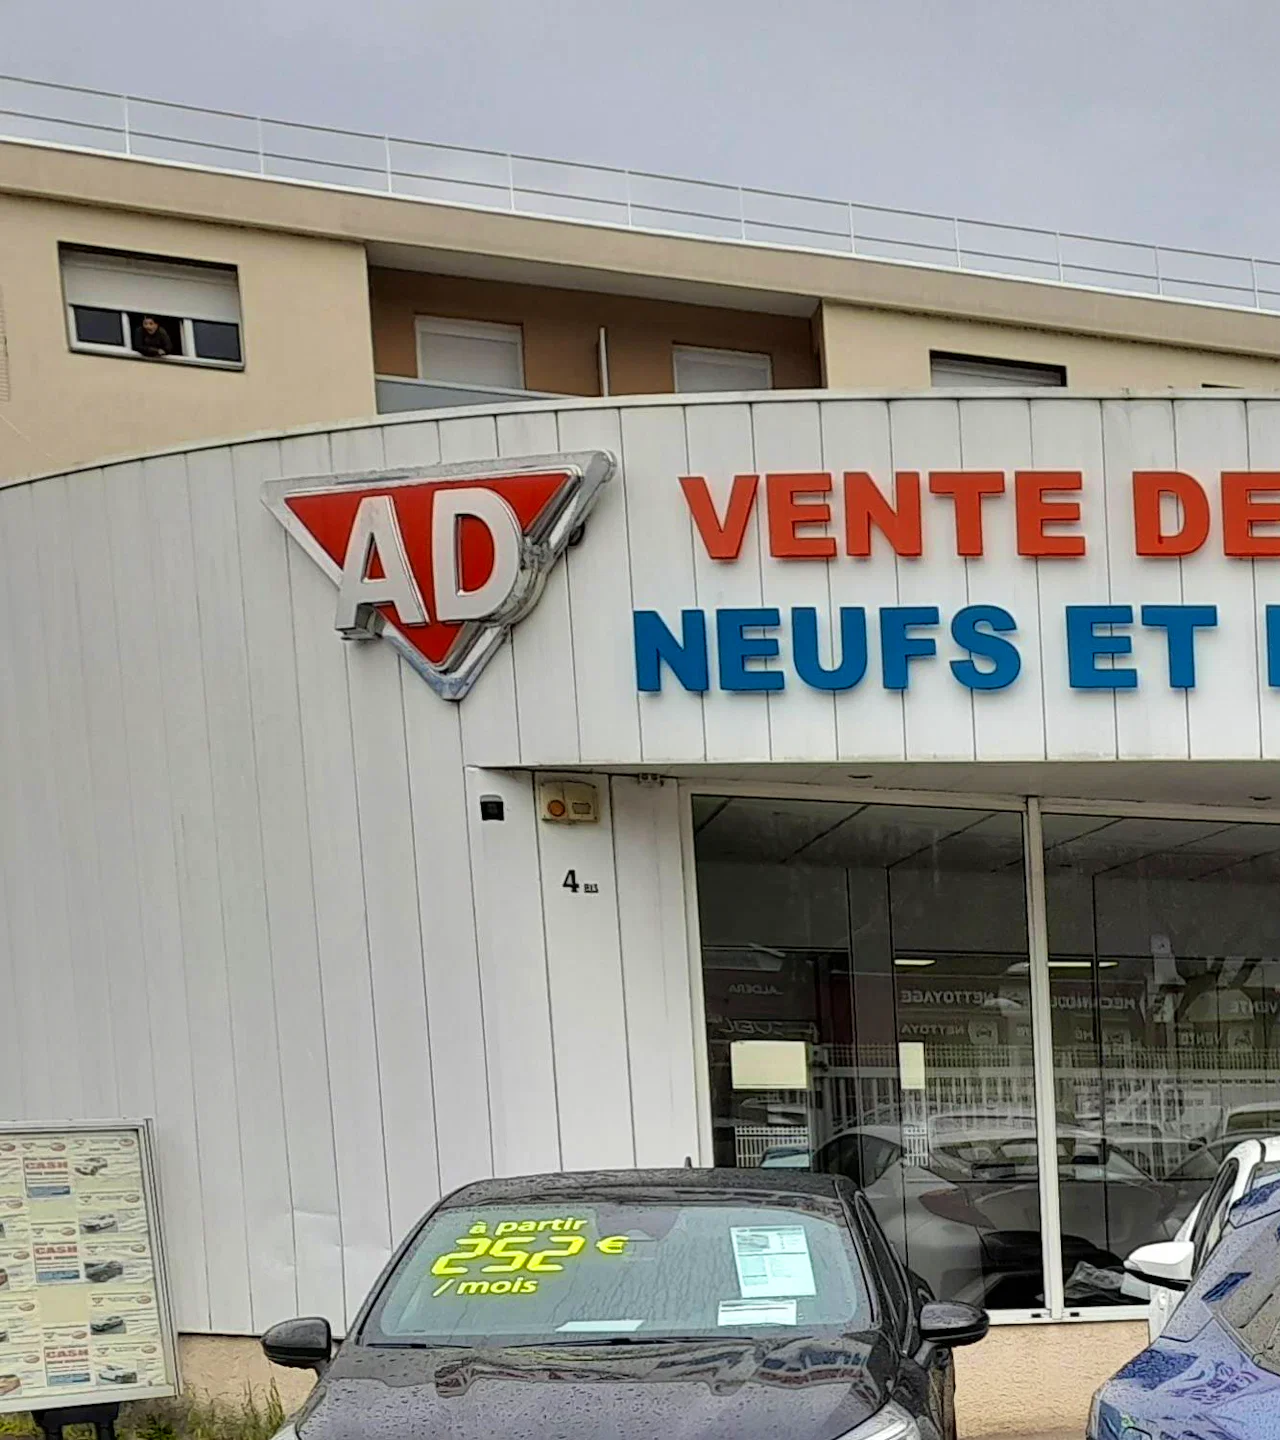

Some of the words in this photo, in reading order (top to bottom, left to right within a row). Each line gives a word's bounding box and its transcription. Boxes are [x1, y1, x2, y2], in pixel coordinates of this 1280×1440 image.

[679, 470, 1087, 561] VENTE
[335, 486, 523, 632] AD
[632, 604, 1022, 693] NEUFS
[1065, 604, 1219, 690] ET
[562, 869, 580, 893] 4
[25, 1161, 68, 1169] CASH
[469, 1221, 487, 1235] à
[495, 1216, 590, 1236] partir
[34, 1246, 78, 1255] CASH
[431, 1235, 586, 1276] 252
[595, 1235, 630, 1256] €
[456, 1277, 540, 1296] mois
[46, 1350, 89, 1358] CASH
